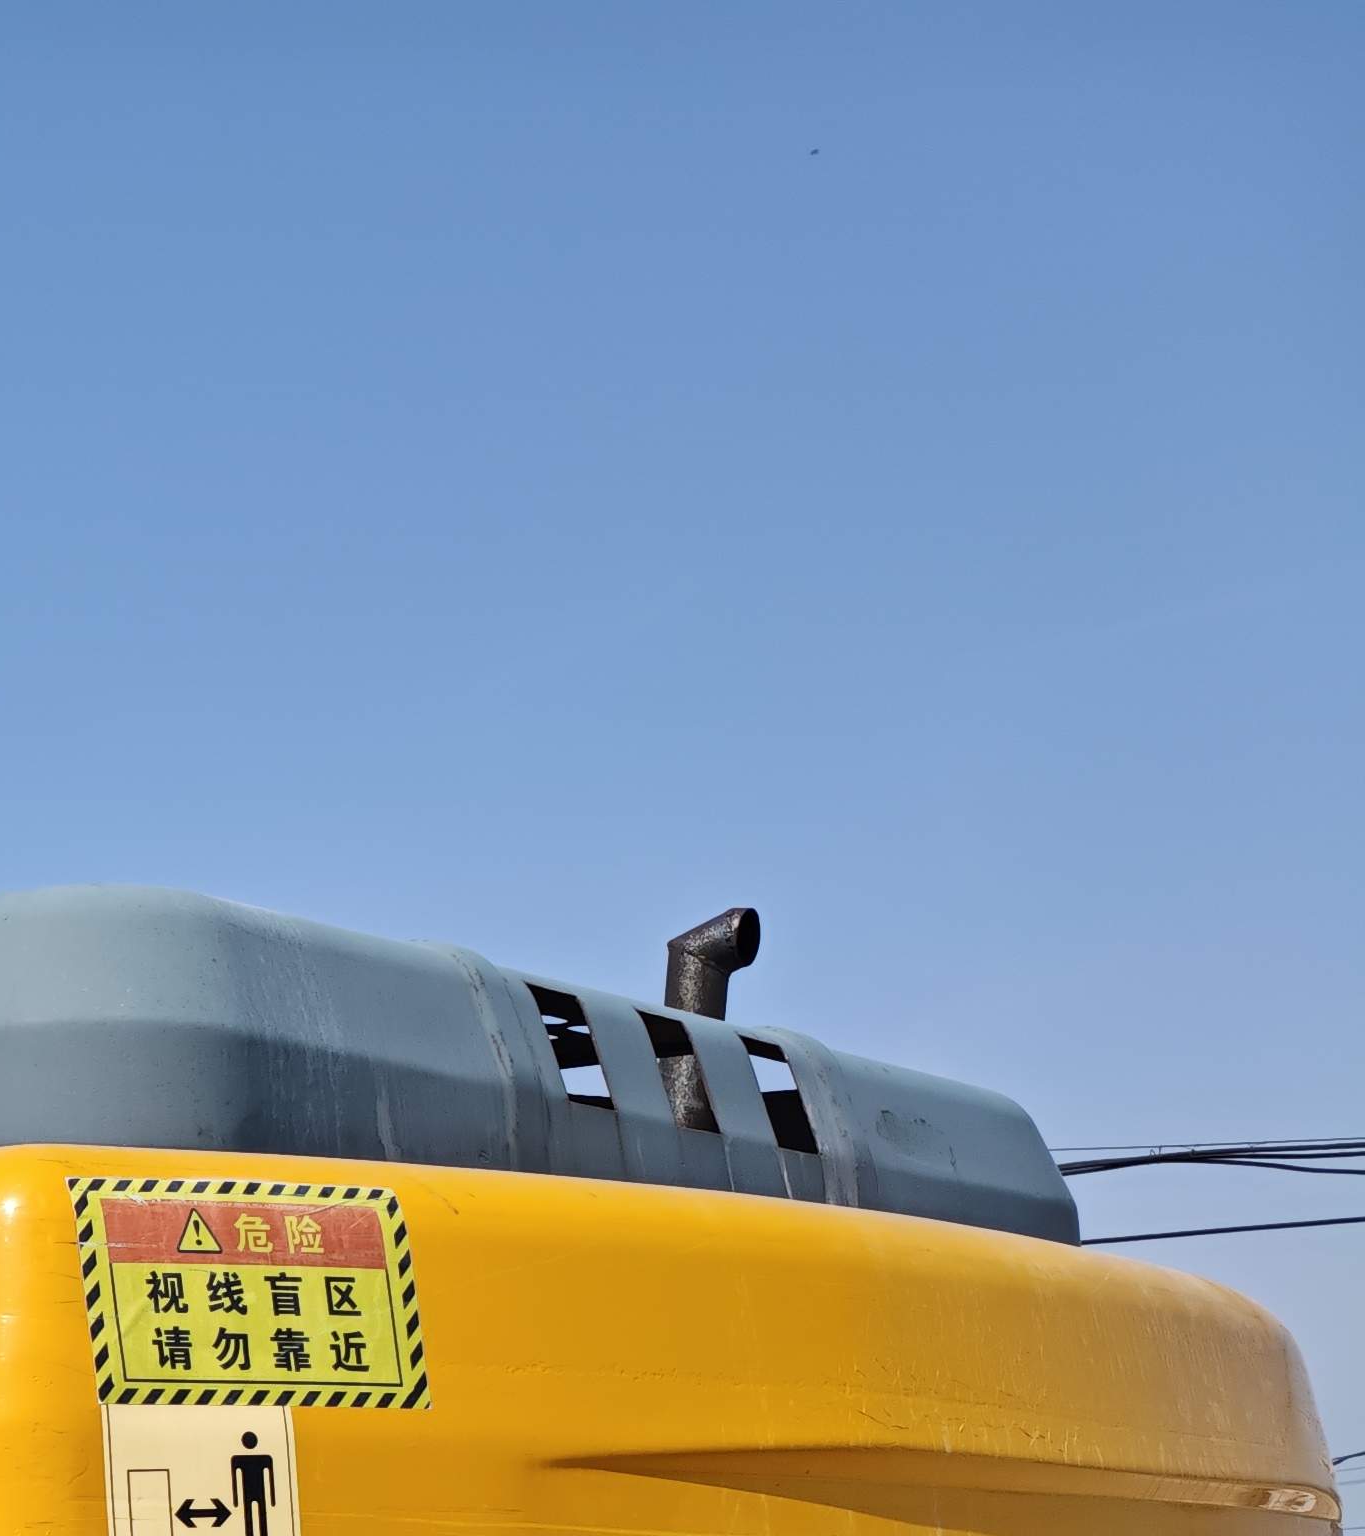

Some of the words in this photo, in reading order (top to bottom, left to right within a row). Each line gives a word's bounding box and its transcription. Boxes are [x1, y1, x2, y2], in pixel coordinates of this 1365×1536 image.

[233, 1213, 326, 1255] 危险
[145, 1271, 363, 1317] 视线盲区
[152, 1327, 371, 1373] 请勿靠近
